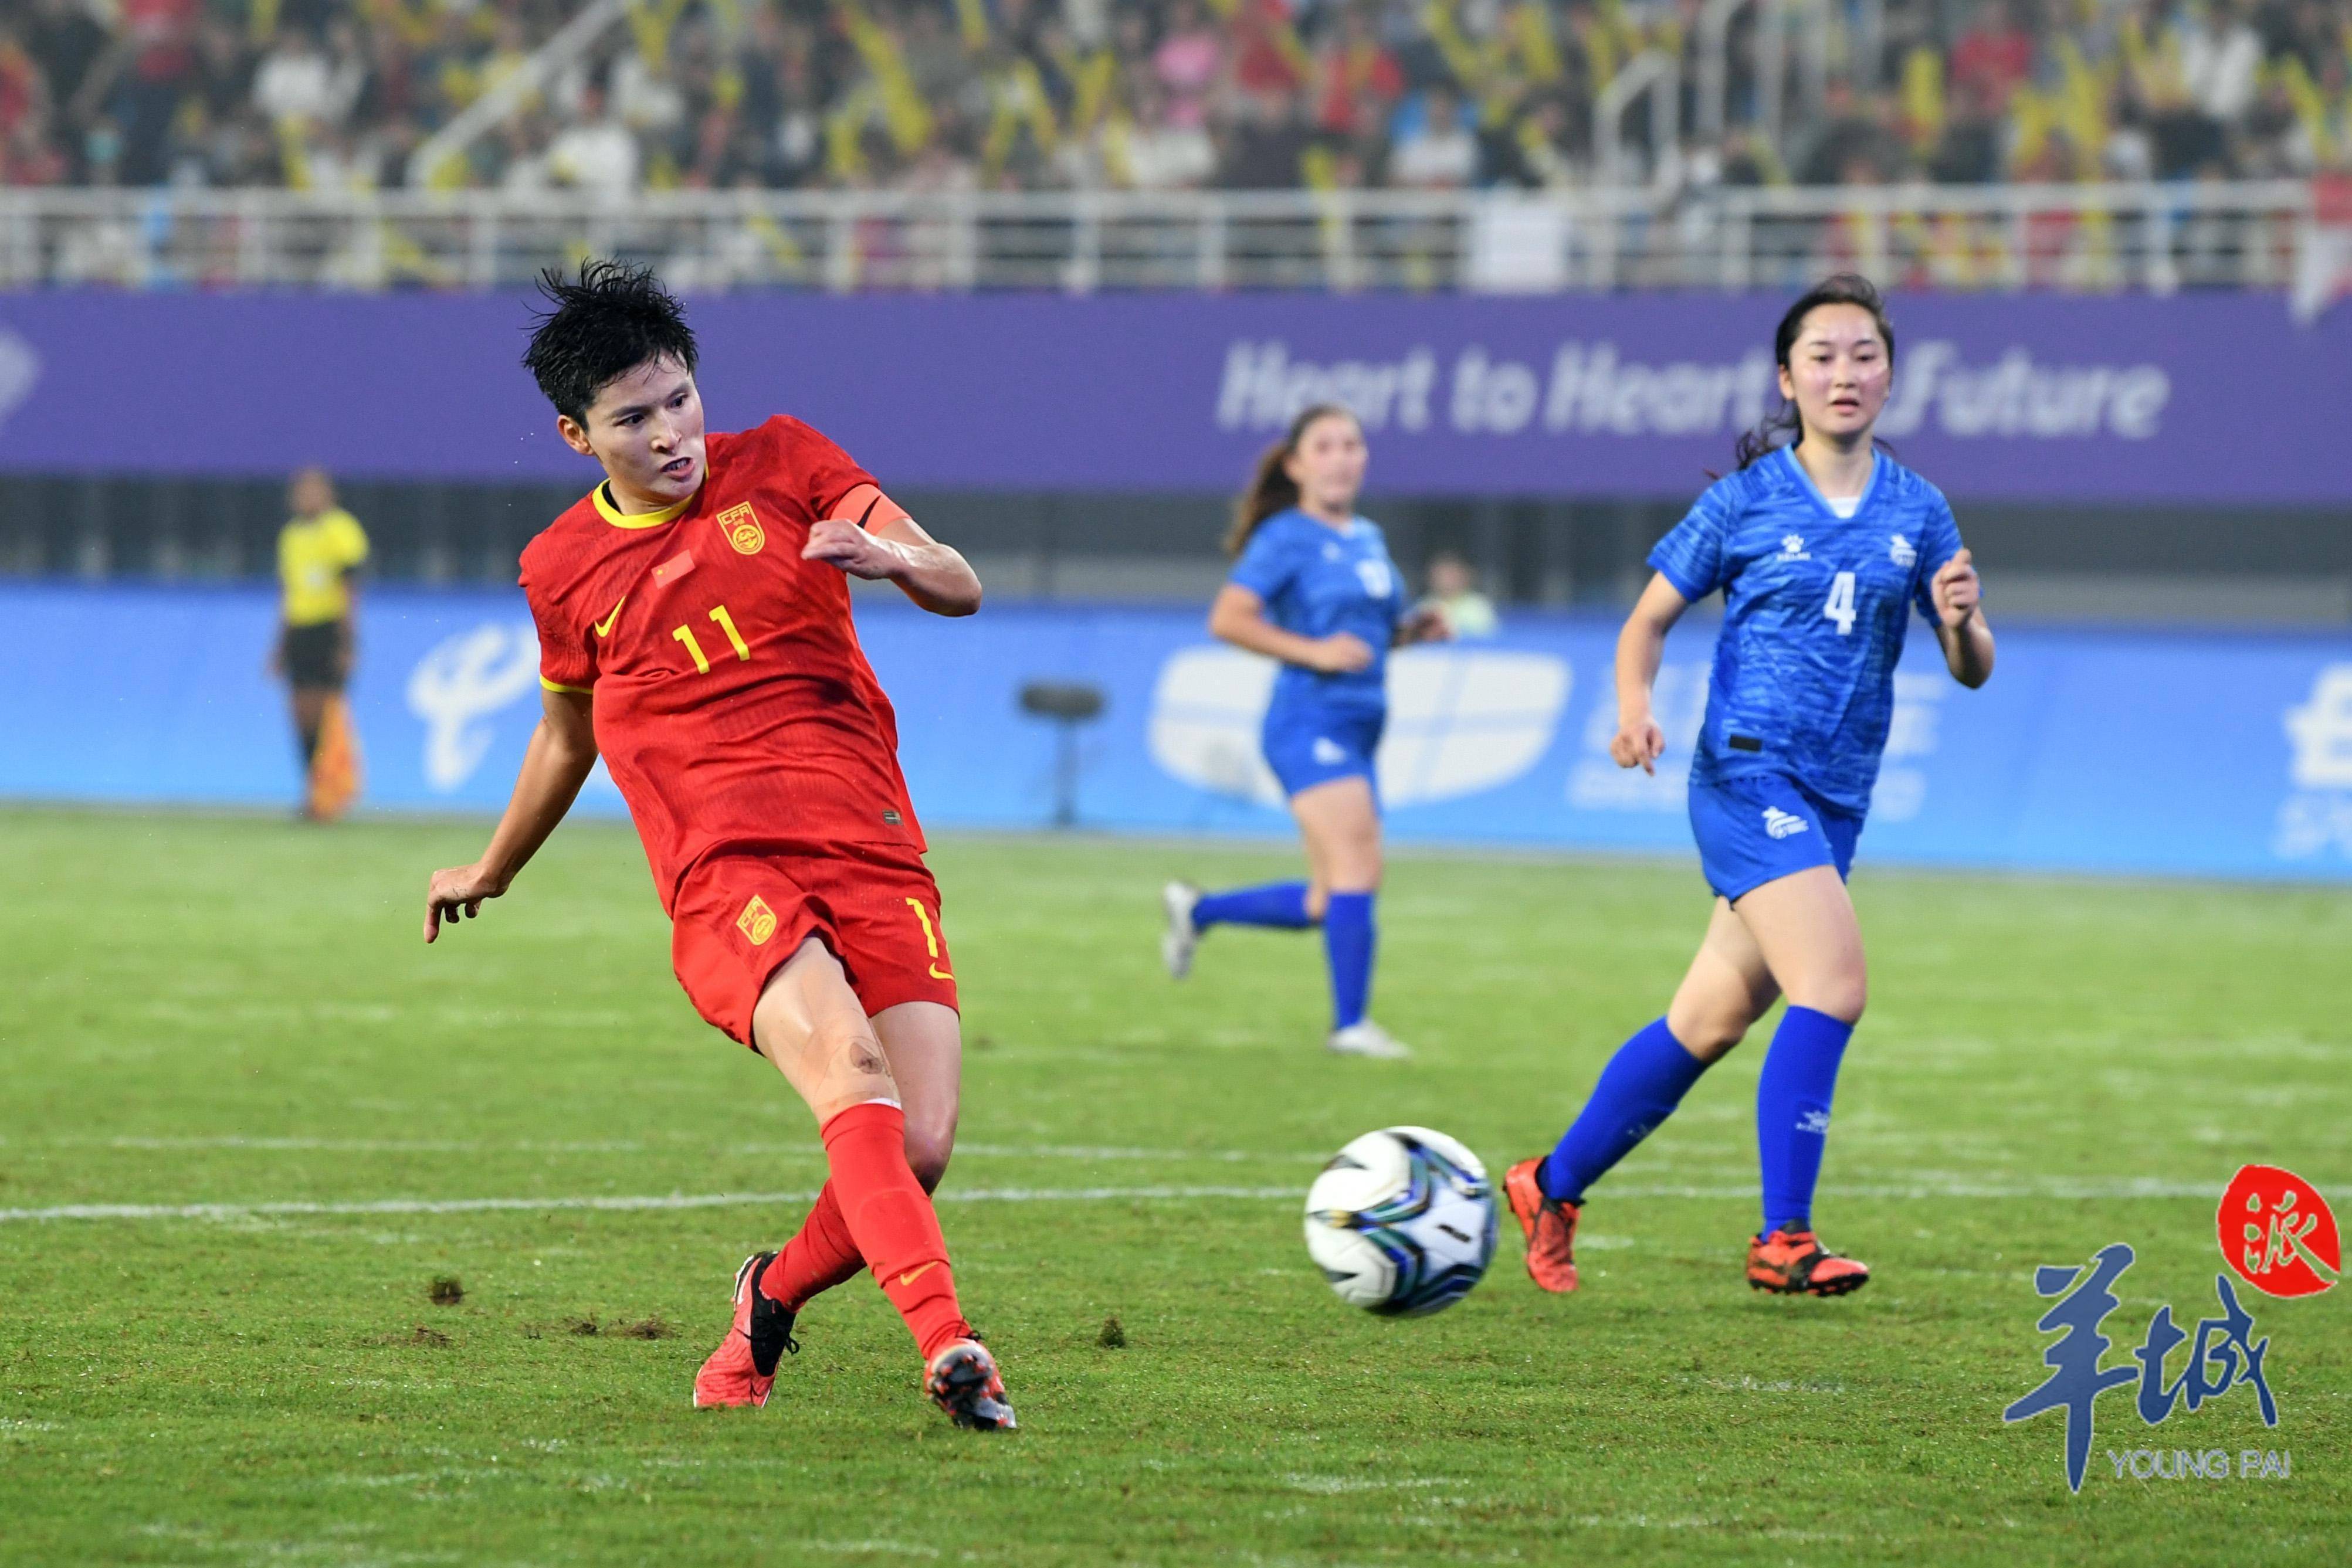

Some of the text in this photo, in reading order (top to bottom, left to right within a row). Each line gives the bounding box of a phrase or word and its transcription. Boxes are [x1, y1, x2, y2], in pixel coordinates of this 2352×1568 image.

[1216, 340, 1436, 432] Heart
[1452, 345, 1538, 435] to
[721, 505, 750, 525] CFA
[1824, 571, 1856, 634] 4
[673, 605, 751, 674] 11
